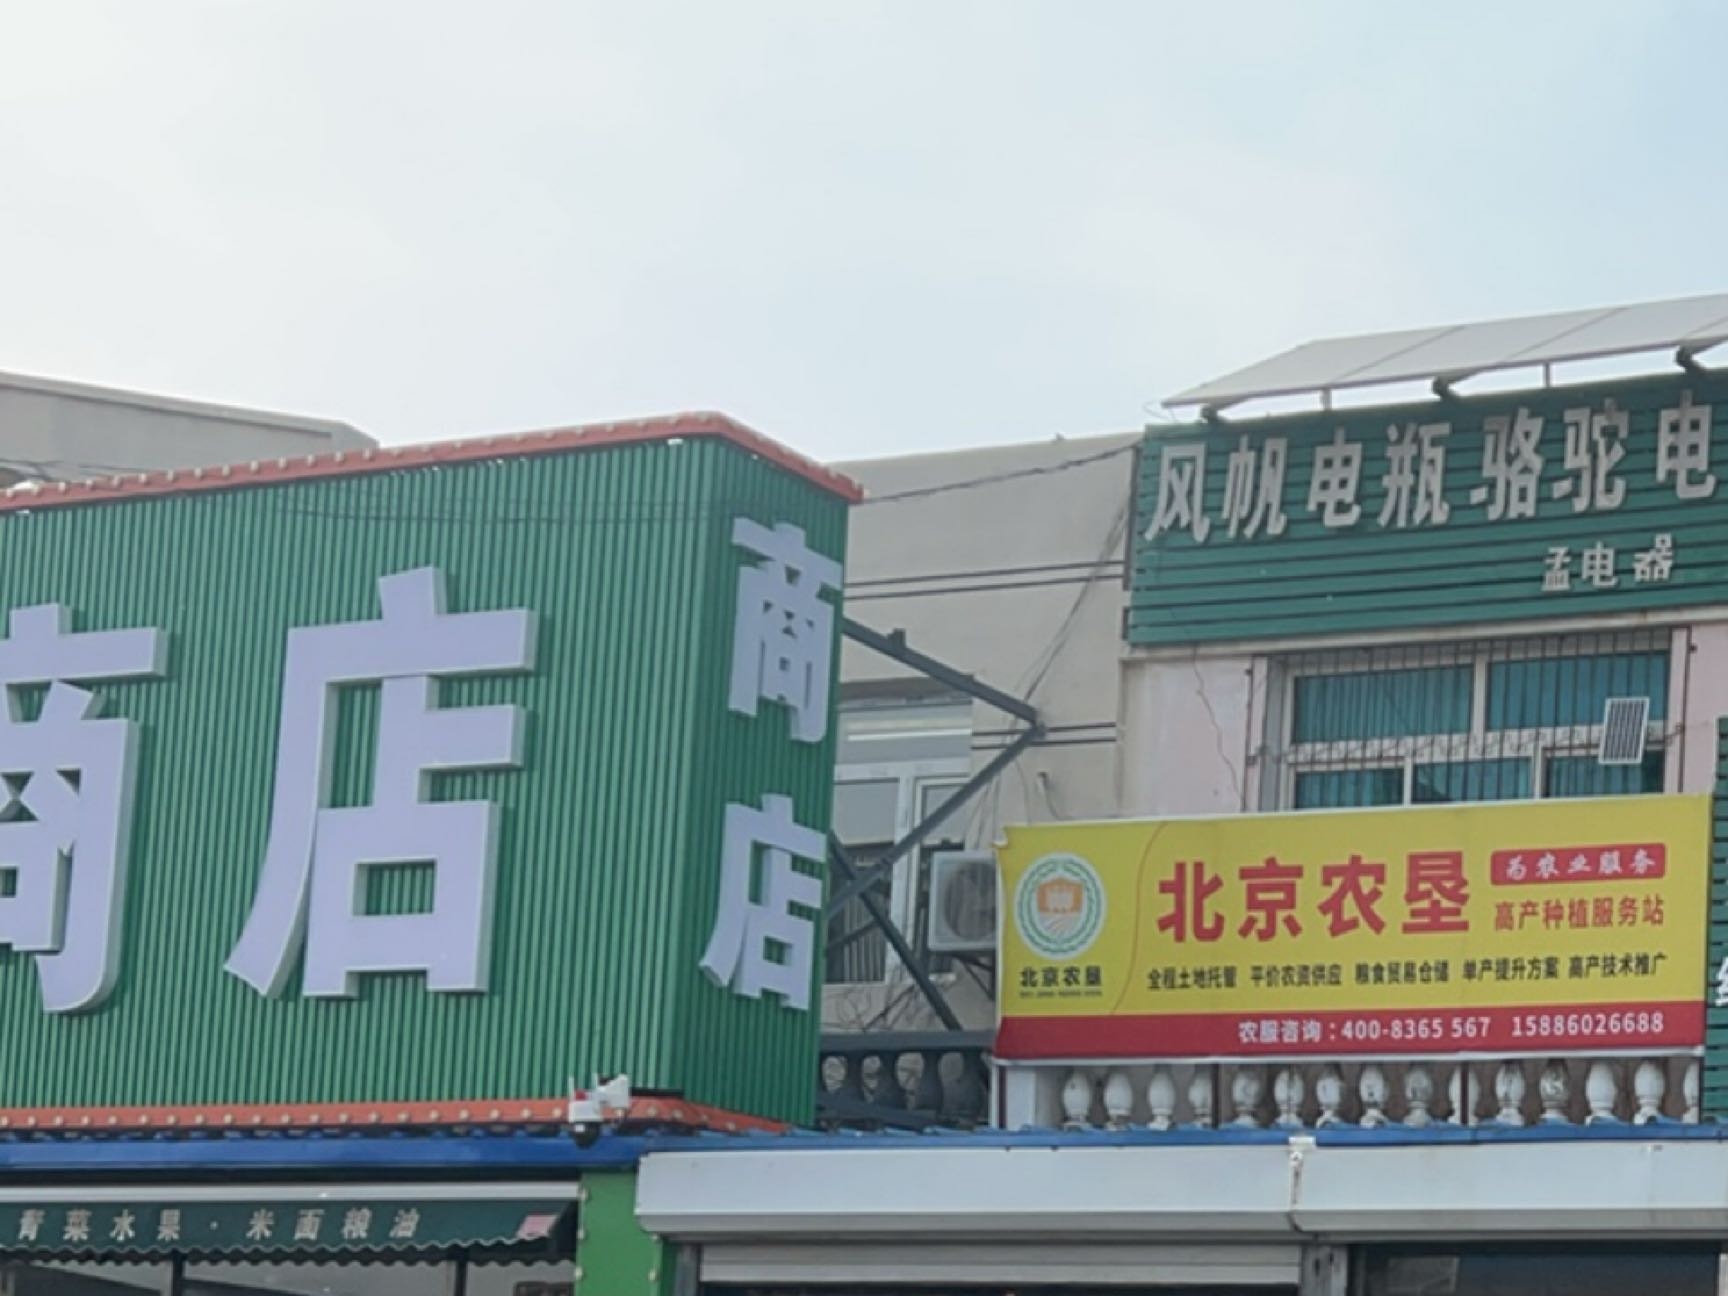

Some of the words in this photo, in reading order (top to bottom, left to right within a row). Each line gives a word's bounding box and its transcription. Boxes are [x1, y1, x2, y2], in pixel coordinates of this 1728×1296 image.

[1540, 533, 1674, 593] 孟电器
[0, 566, 538, 1015] 商店
[699, 515, 842, 1011] 商店
[1156, 850, 1471, 944] 北京农垦
[1495, 893, 1665, 932] 高产种植服务站
[1462, 956, 1559, 982] 单产提升方案
[1568, 951, 1668, 980] 高产技术推广
